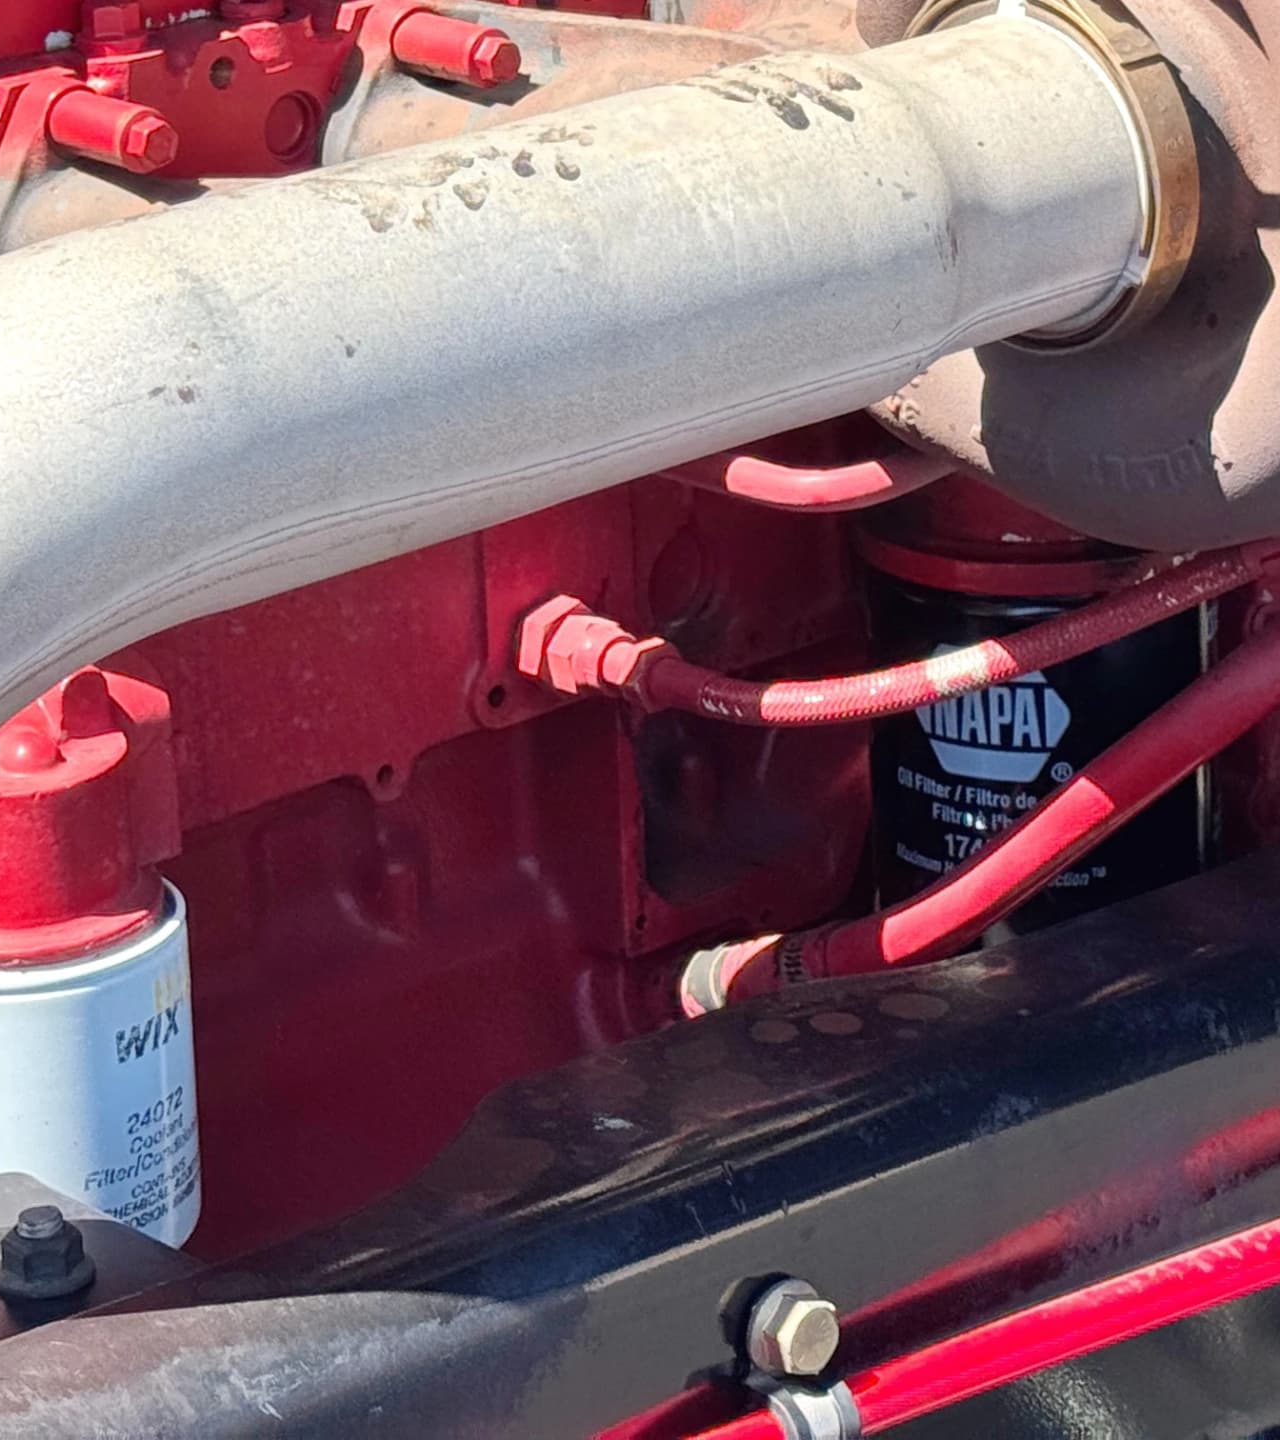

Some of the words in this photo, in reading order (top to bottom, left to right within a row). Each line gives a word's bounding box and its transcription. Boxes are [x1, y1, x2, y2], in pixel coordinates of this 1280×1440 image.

[934, 686, 1042, 748] NAPA
[914, 772, 952, 799] Filter
[965, 786, 1011, 808] Filtro
[115, 1007, 179, 1064] WIX
[126, 1085, 183, 1135] 24072
